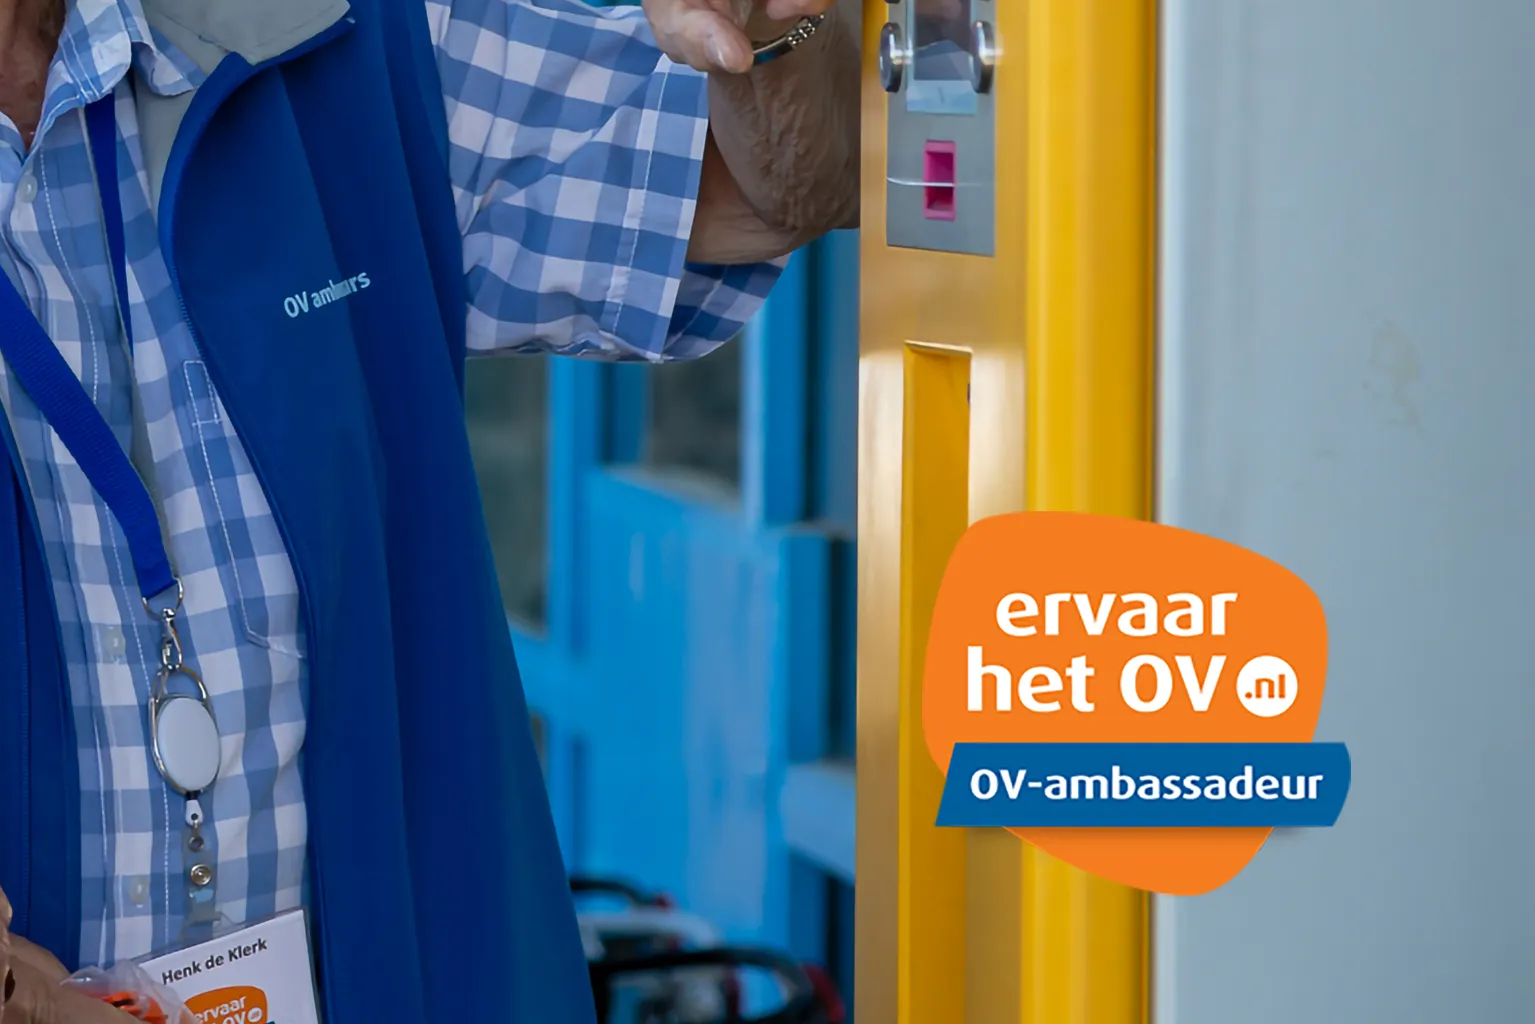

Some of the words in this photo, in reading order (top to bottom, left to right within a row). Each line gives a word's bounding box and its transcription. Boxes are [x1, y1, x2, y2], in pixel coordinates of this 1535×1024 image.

[283, 290, 309, 318] OV
[161, 960, 202, 986] Henk
[205, 954, 225, 970] de
[227, 937, 268, 962] Klerk
